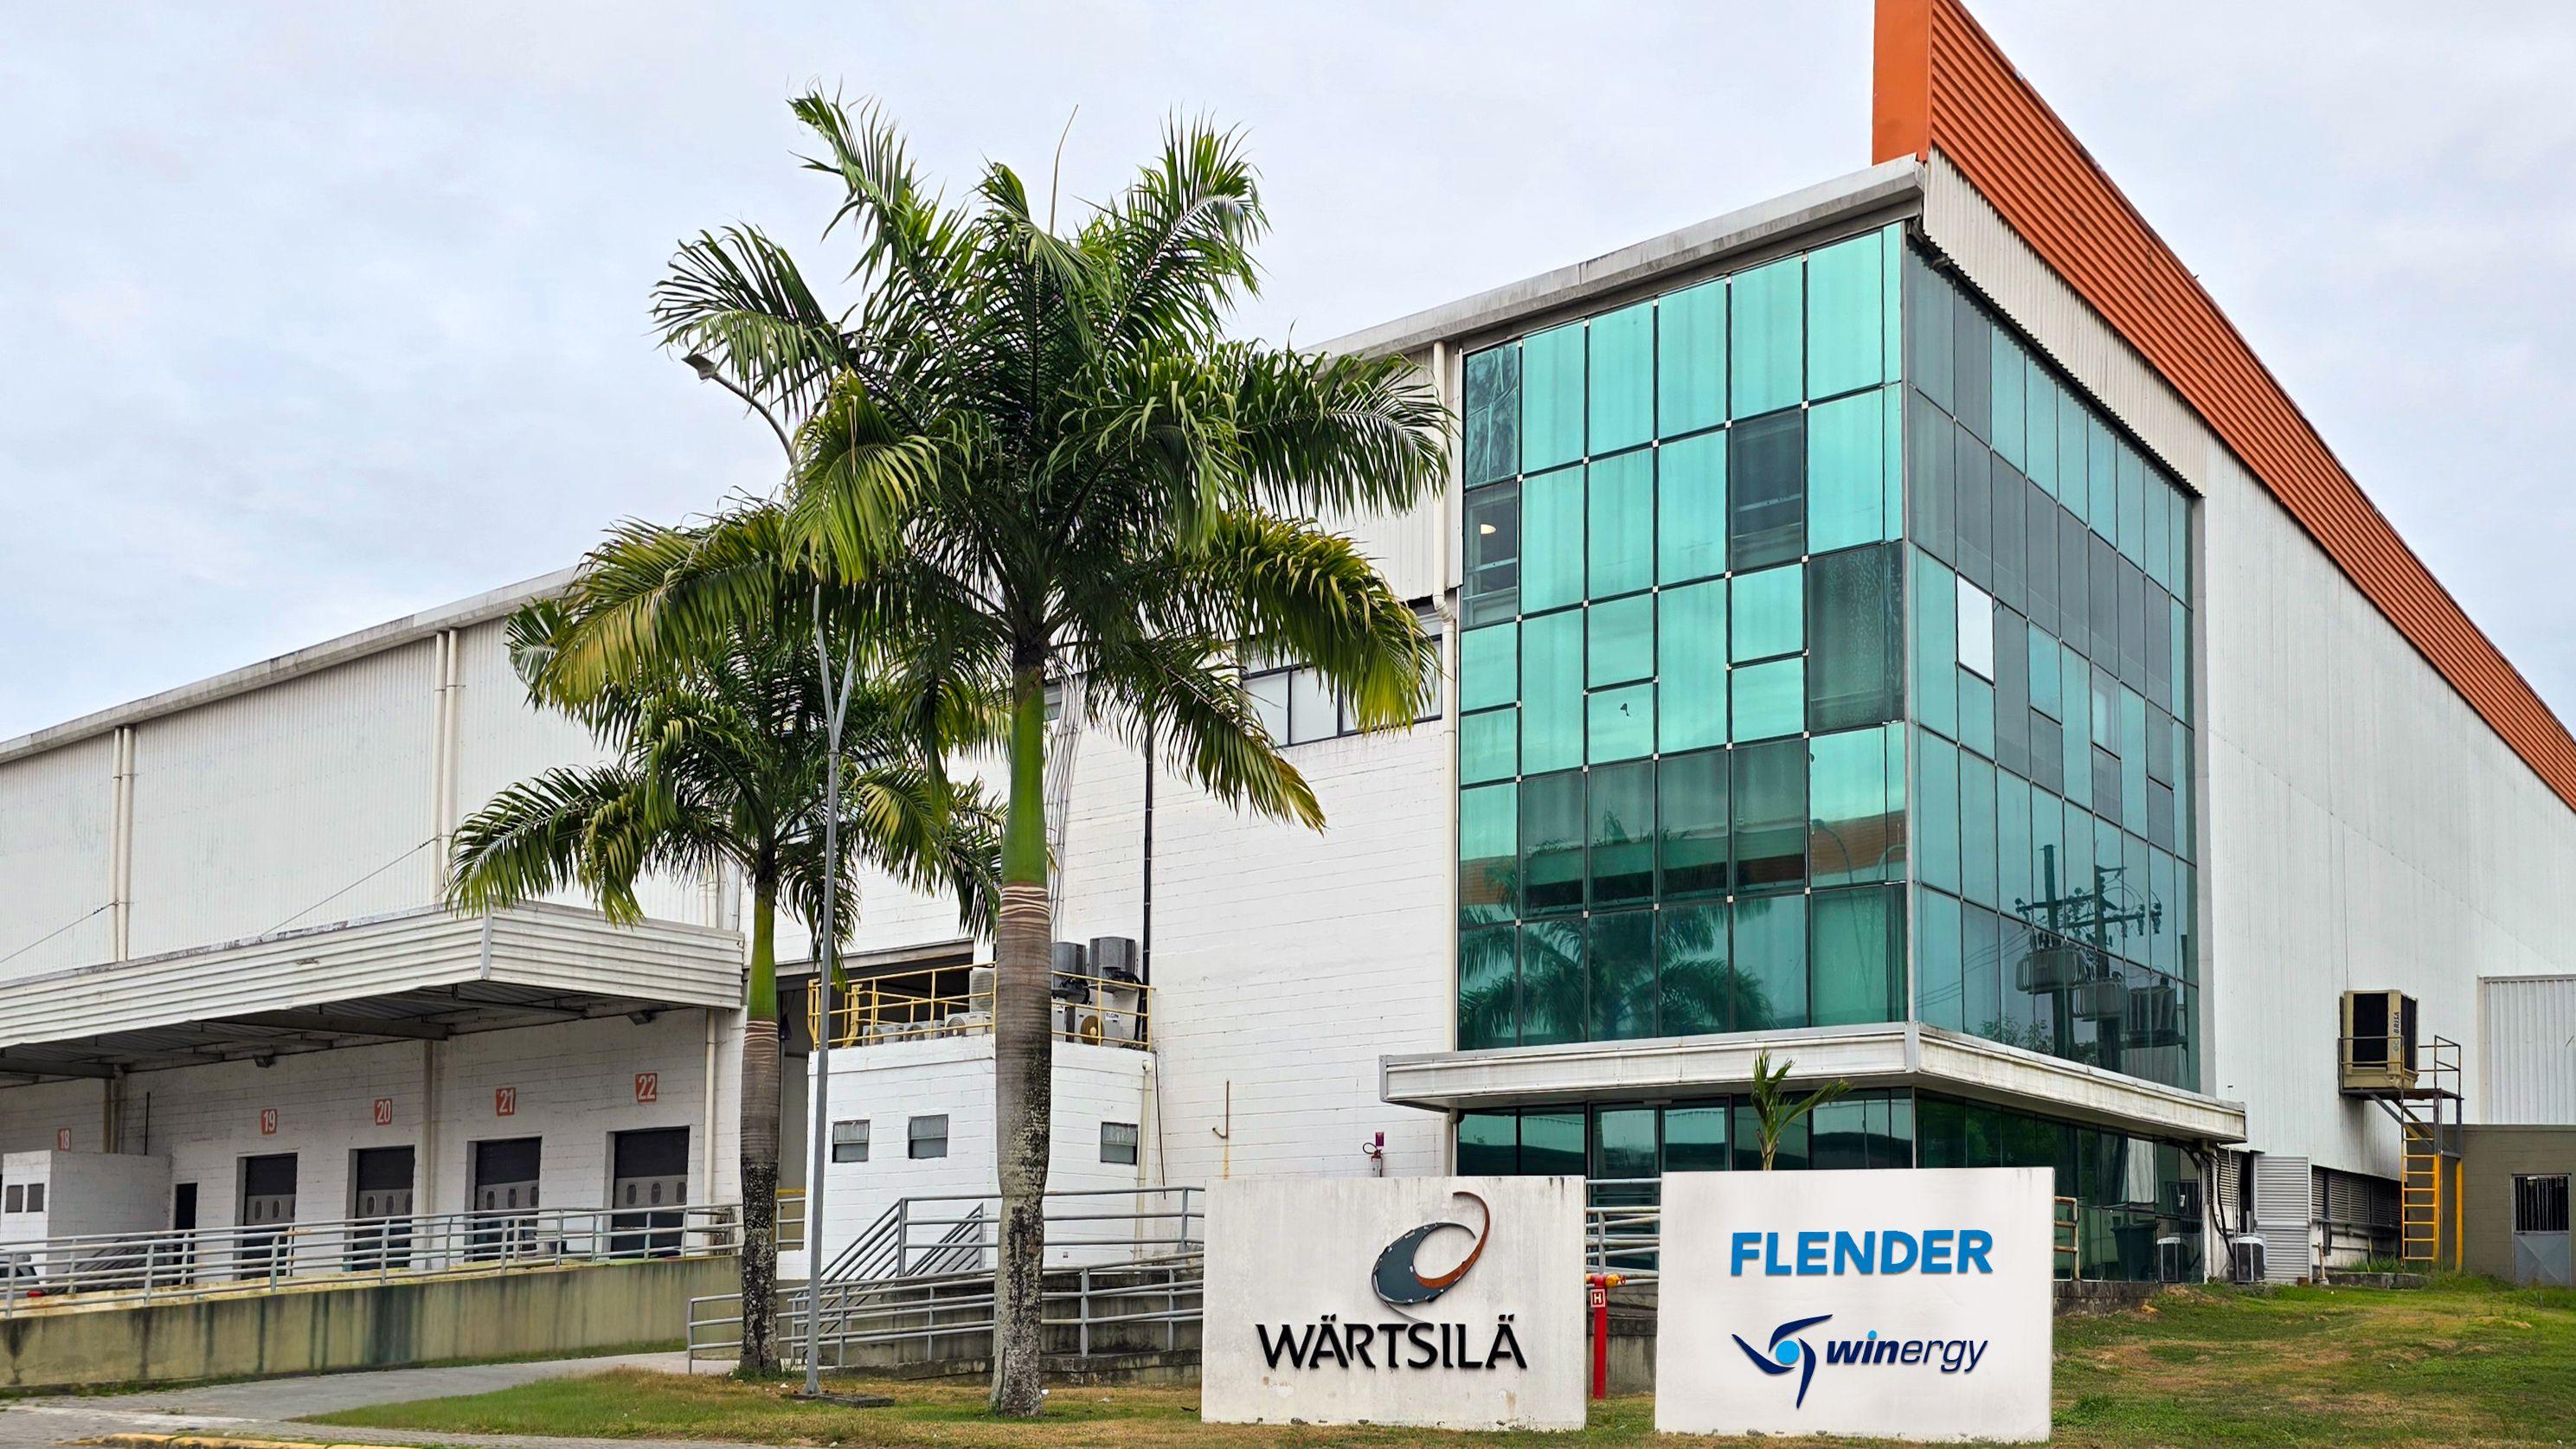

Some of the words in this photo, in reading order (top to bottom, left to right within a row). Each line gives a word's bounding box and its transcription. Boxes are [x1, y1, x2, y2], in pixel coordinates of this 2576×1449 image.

[638, 1075, 657, 1100] 22
[376, 1100, 390, 1123] 20
[498, 1089, 514, 1113] 21
[263, 1111, 277, 1133] 19
[60, 1129, 70, 1150] 18
[1731, 1229, 1994, 1276] FLENDER
[1593, 1292, 1603, 1305] H
[1255, 1313, 1528, 1370] WÄRTSILÄ
[1827, 1330, 1988, 1374] winergy
